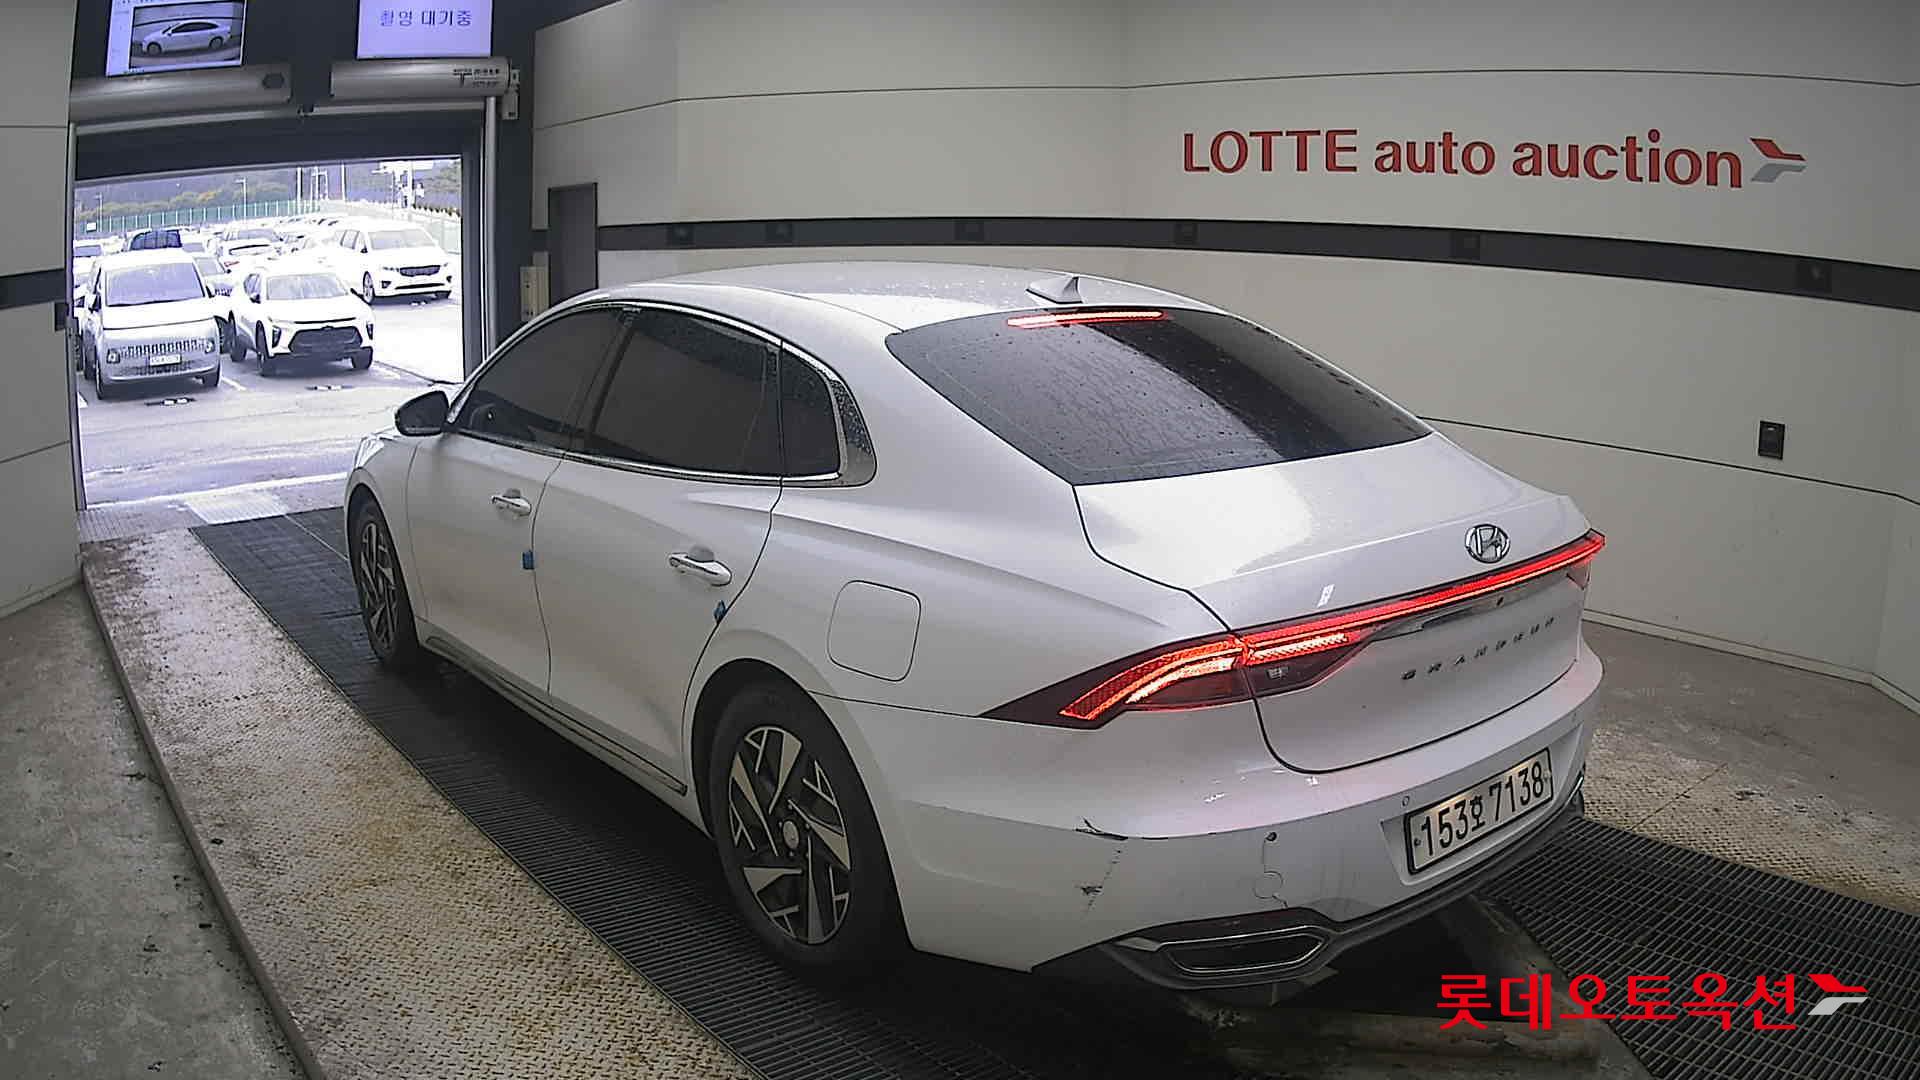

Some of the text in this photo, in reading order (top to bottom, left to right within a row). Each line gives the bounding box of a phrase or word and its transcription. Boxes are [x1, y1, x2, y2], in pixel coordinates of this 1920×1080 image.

[421, 10, 471, 26] 대기중
[1184, 129, 1743, 188] LOTTE auto auction
[1489, 761, 1544, 821] 7138
